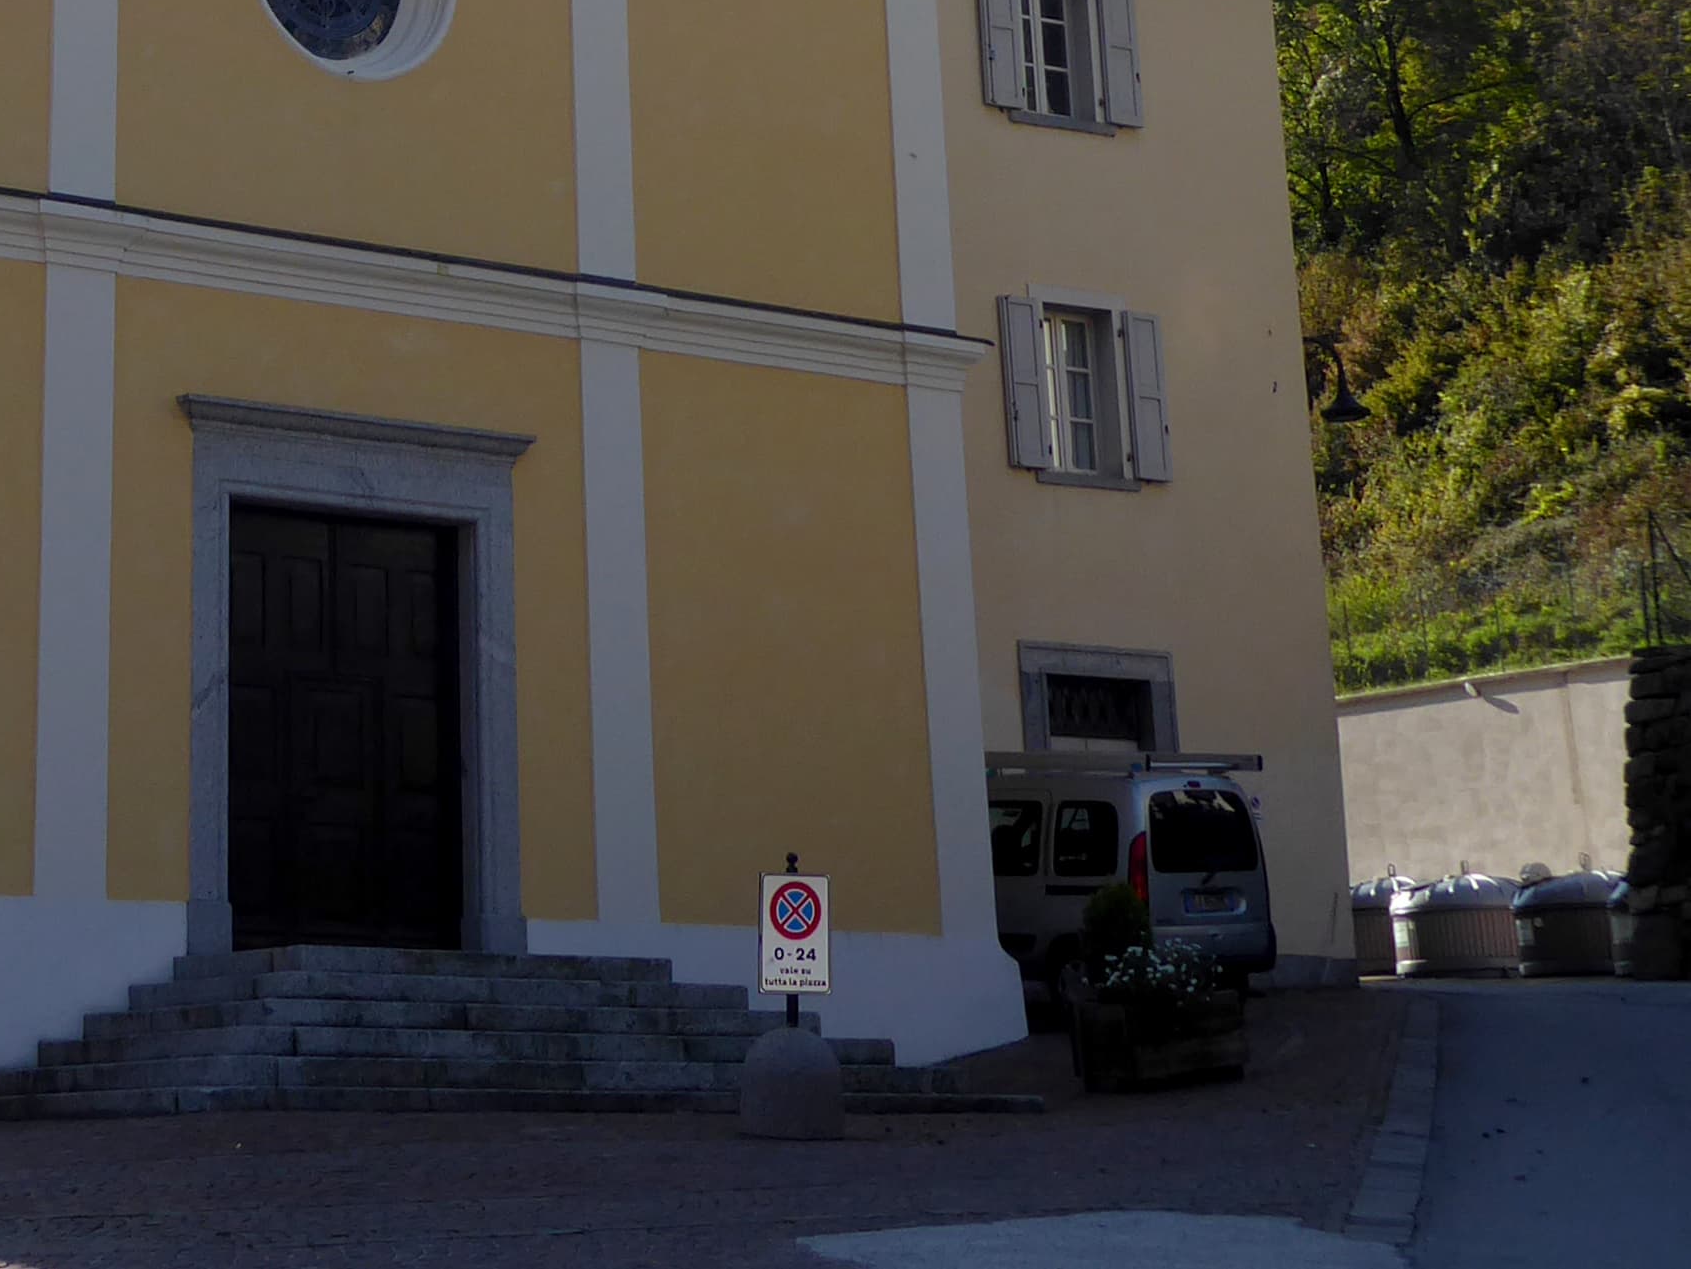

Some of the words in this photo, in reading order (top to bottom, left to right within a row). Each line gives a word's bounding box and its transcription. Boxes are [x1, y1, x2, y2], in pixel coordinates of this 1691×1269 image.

[779, 966, 798, 974] vale
[764, 977, 787, 986] tutta
[789, 977, 797, 986] la
[799, 978, 826, 987] piazza
